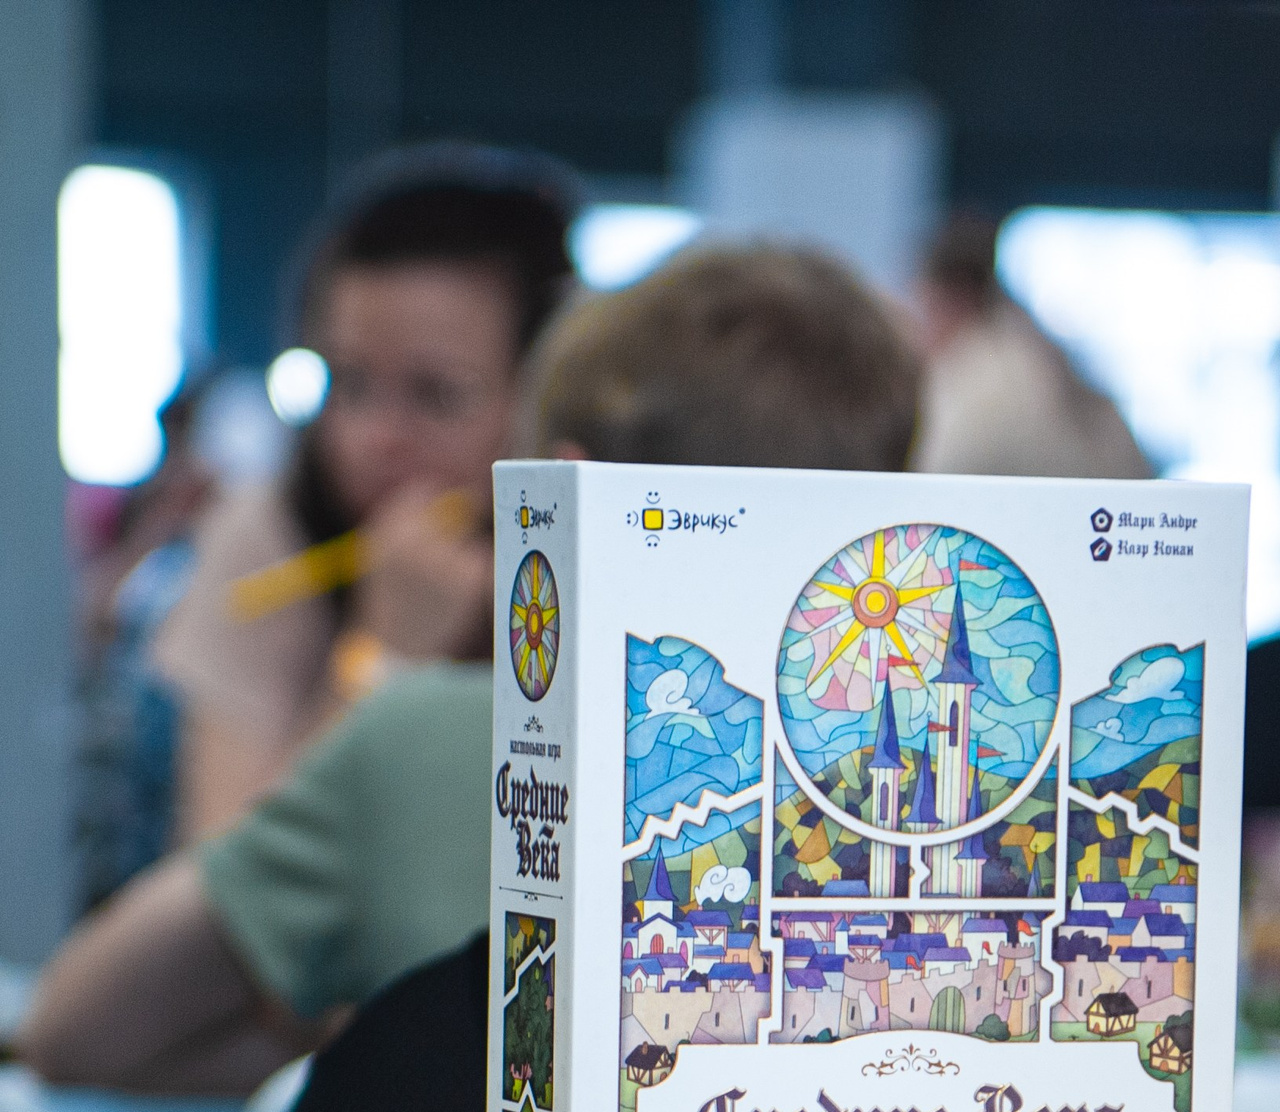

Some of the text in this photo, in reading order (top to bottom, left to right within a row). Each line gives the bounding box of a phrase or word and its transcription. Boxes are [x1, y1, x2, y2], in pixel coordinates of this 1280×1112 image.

[667, 509, 738, 534] Эврикус
[1159, 512, 1198, 532] Андре
[1153, 540, 1194, 556] Конан
[496, 759, 569, 831] Средние
[516, 819, 561, 882] Века
